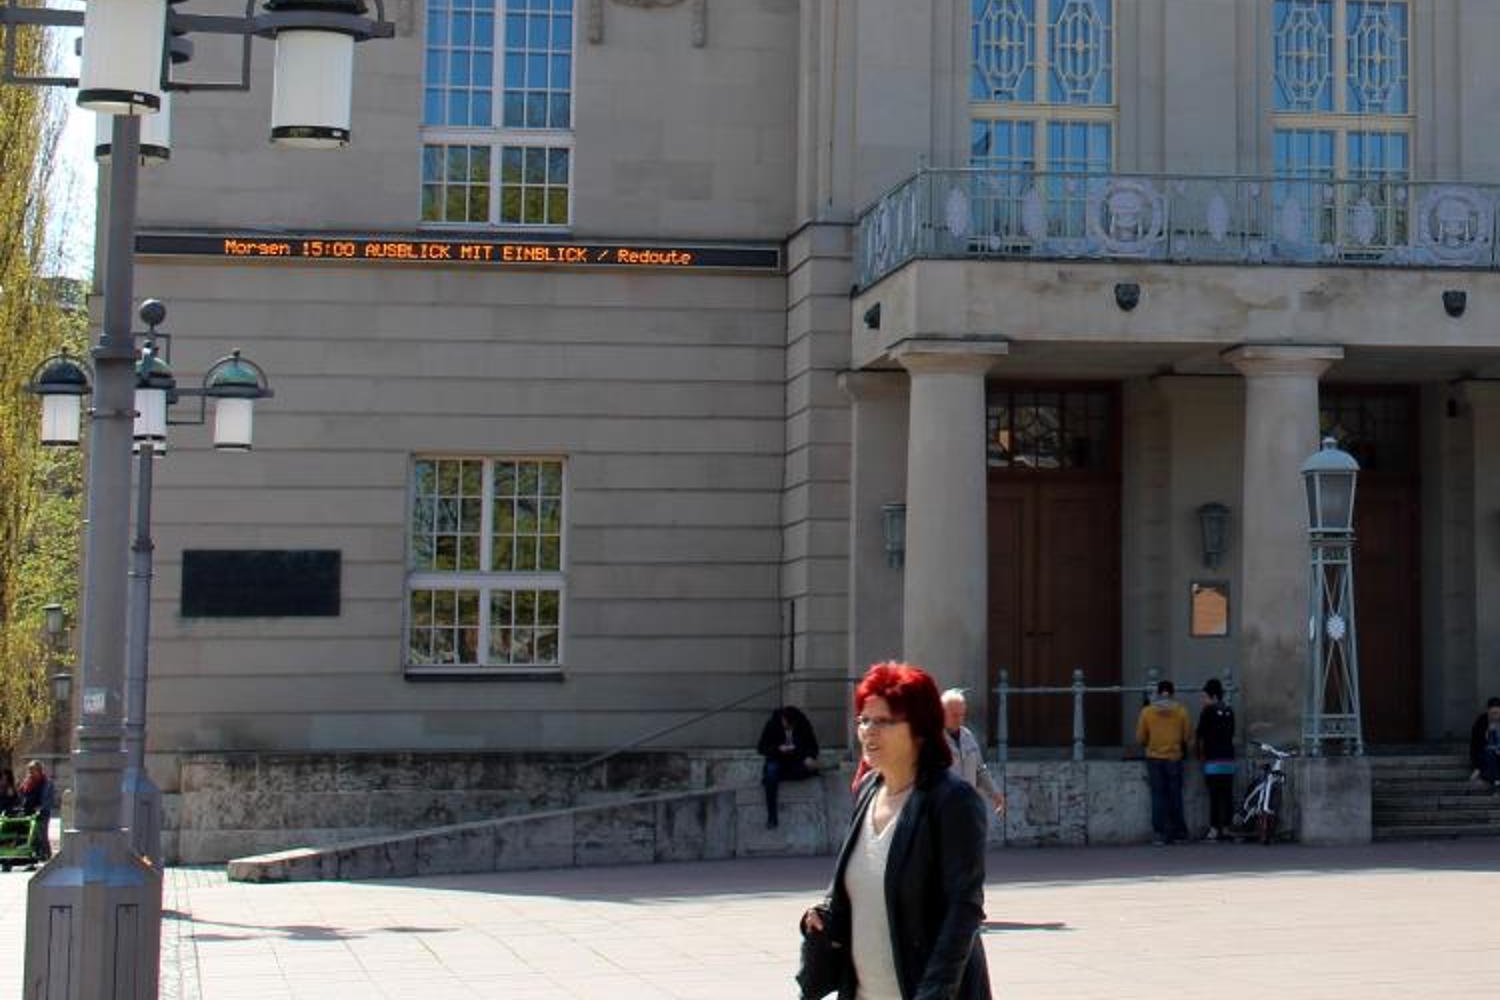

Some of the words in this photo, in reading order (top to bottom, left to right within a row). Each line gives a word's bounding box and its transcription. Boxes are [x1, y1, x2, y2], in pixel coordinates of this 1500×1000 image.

[365, 243, 449, 258] AUSBLICK
[461, 246, 493, 260] MIT
[503, 246, 587, 261] EINBLICK
[618, 249, 690, 264] Redoute
